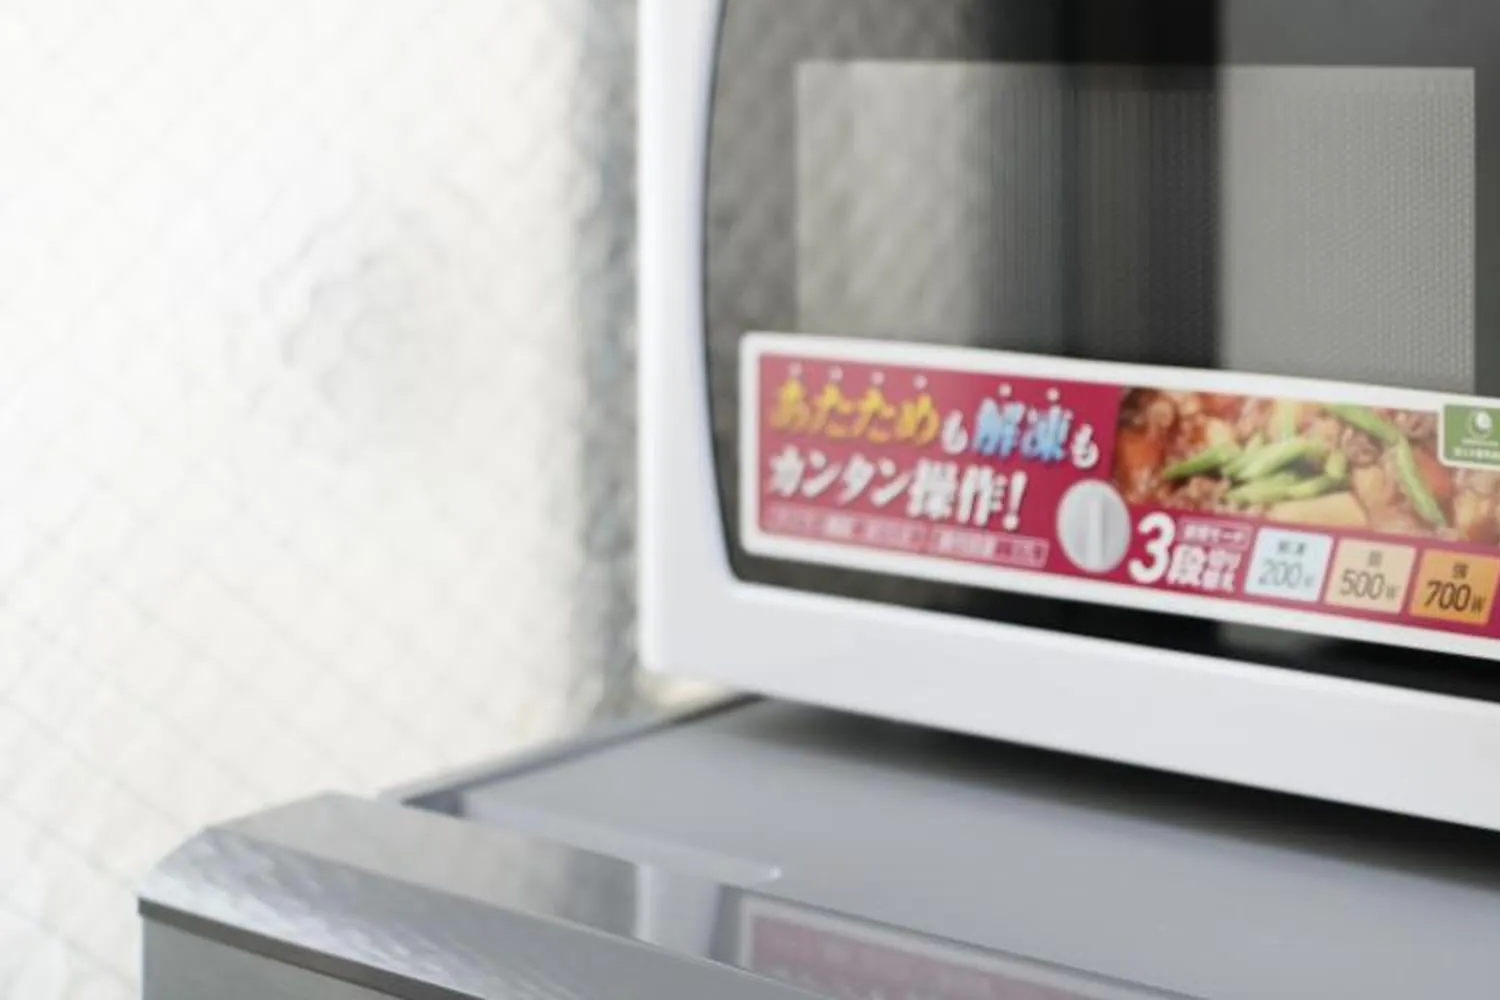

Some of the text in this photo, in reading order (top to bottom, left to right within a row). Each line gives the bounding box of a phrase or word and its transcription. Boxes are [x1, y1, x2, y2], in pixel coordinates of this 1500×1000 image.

[770, 445, 1027, 531] カンタン操作!
[1339, 568, 1397, 600] 500W
[1423, 580, 1486, 614] 700W
